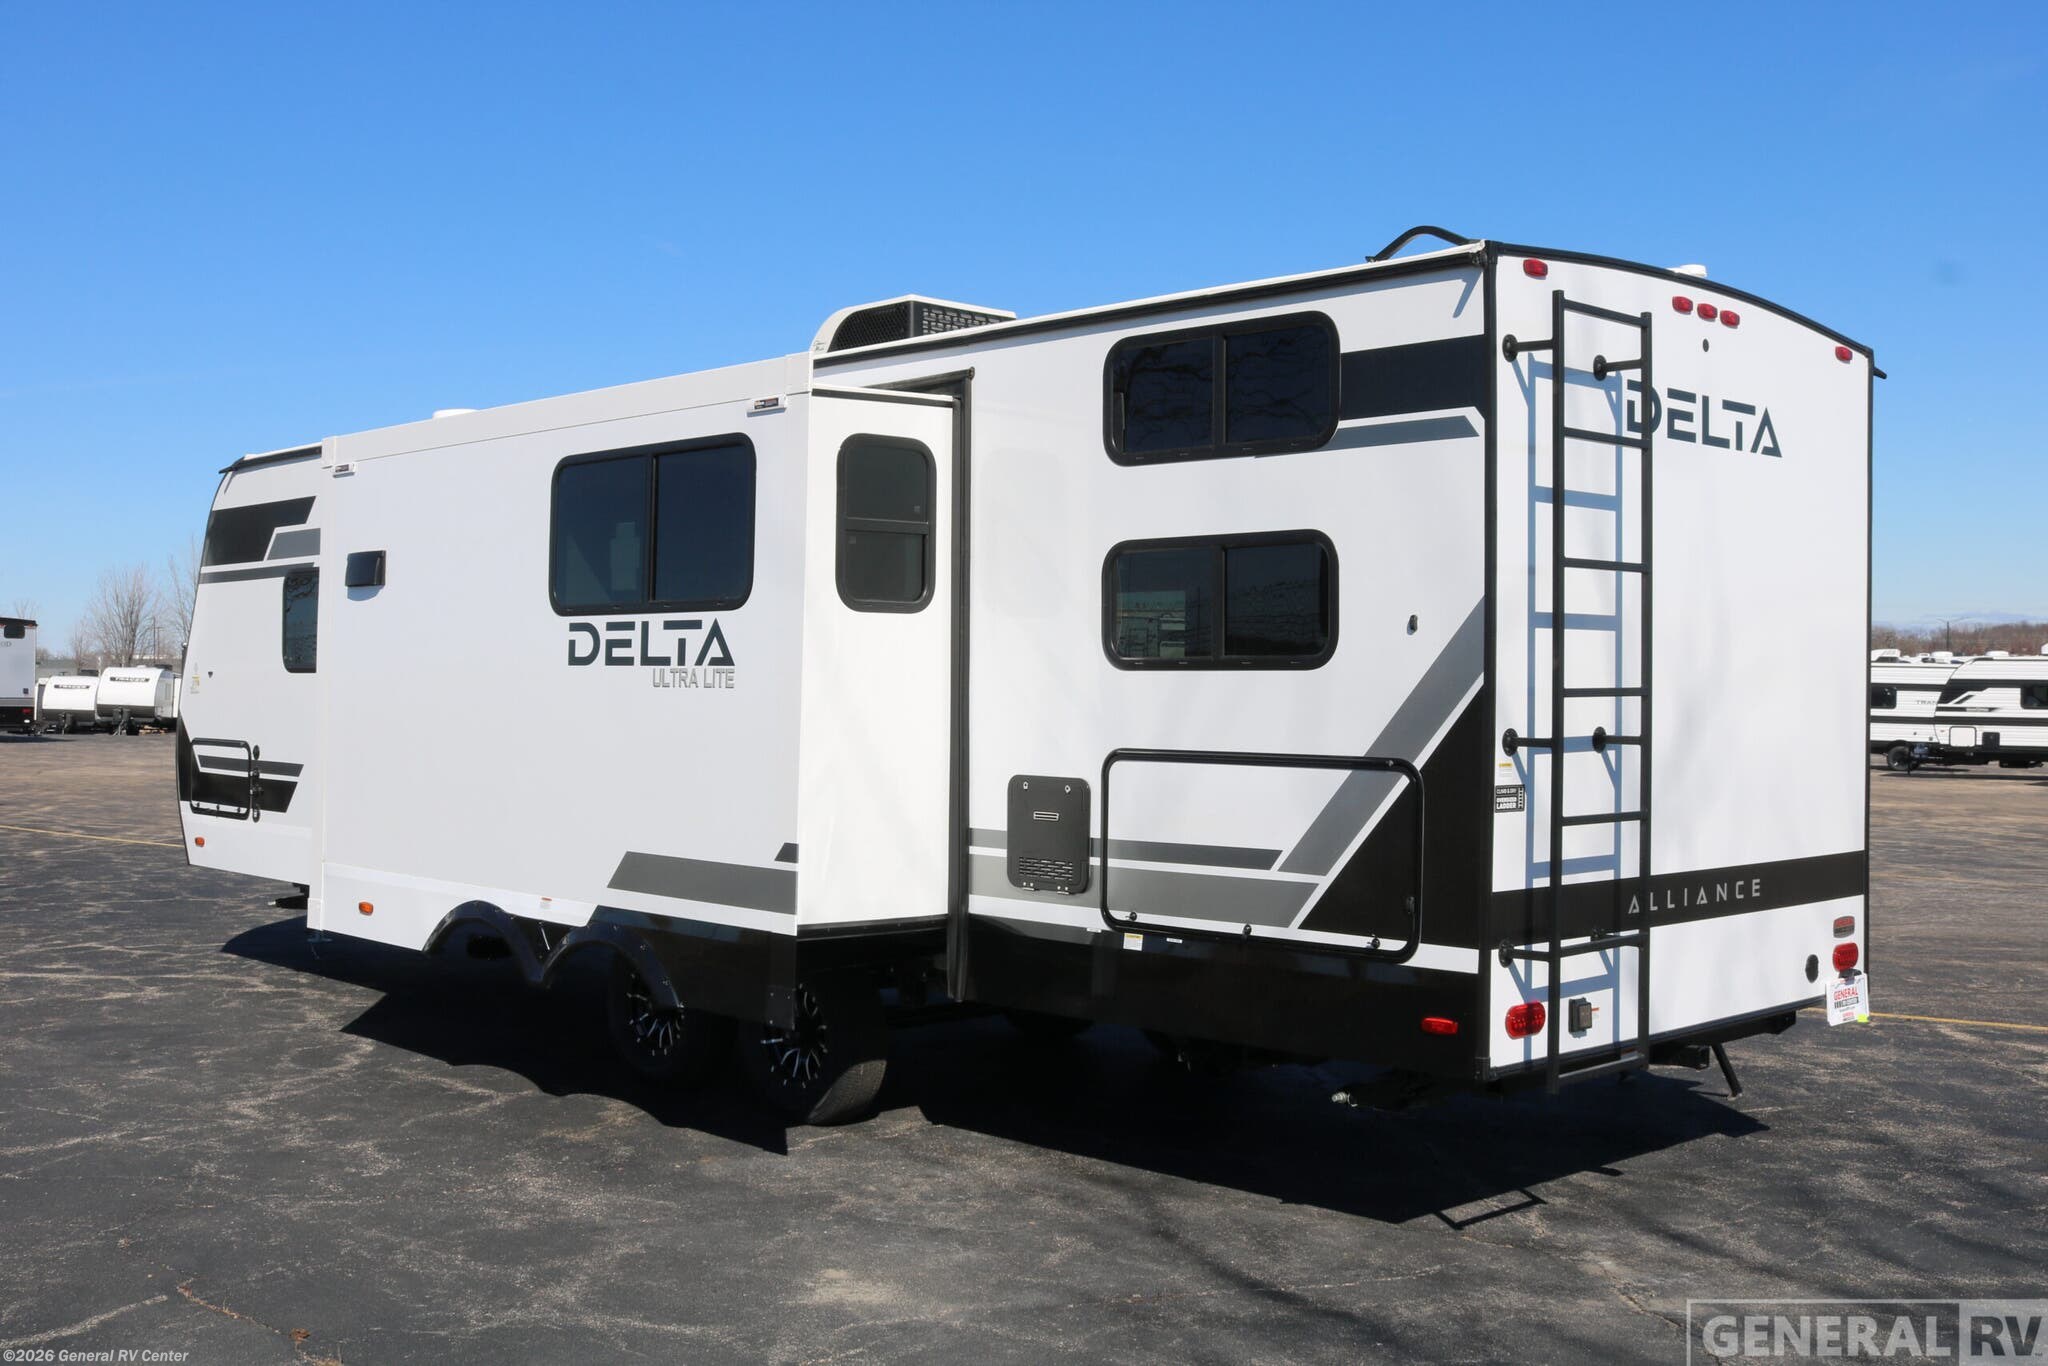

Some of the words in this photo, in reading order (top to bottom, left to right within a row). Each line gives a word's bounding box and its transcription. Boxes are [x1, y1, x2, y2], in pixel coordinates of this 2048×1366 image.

[1626, 378, 1783, 459] DELTA
[567, 617, 736, 667] DELTA
[652, 667, 699, 689] ULTRA
[703, 668, 736, 690] LITE
[1628, 878, 1761, 915] ALLIANCE
[1833, 986, 1859, 1001] GENERAL
